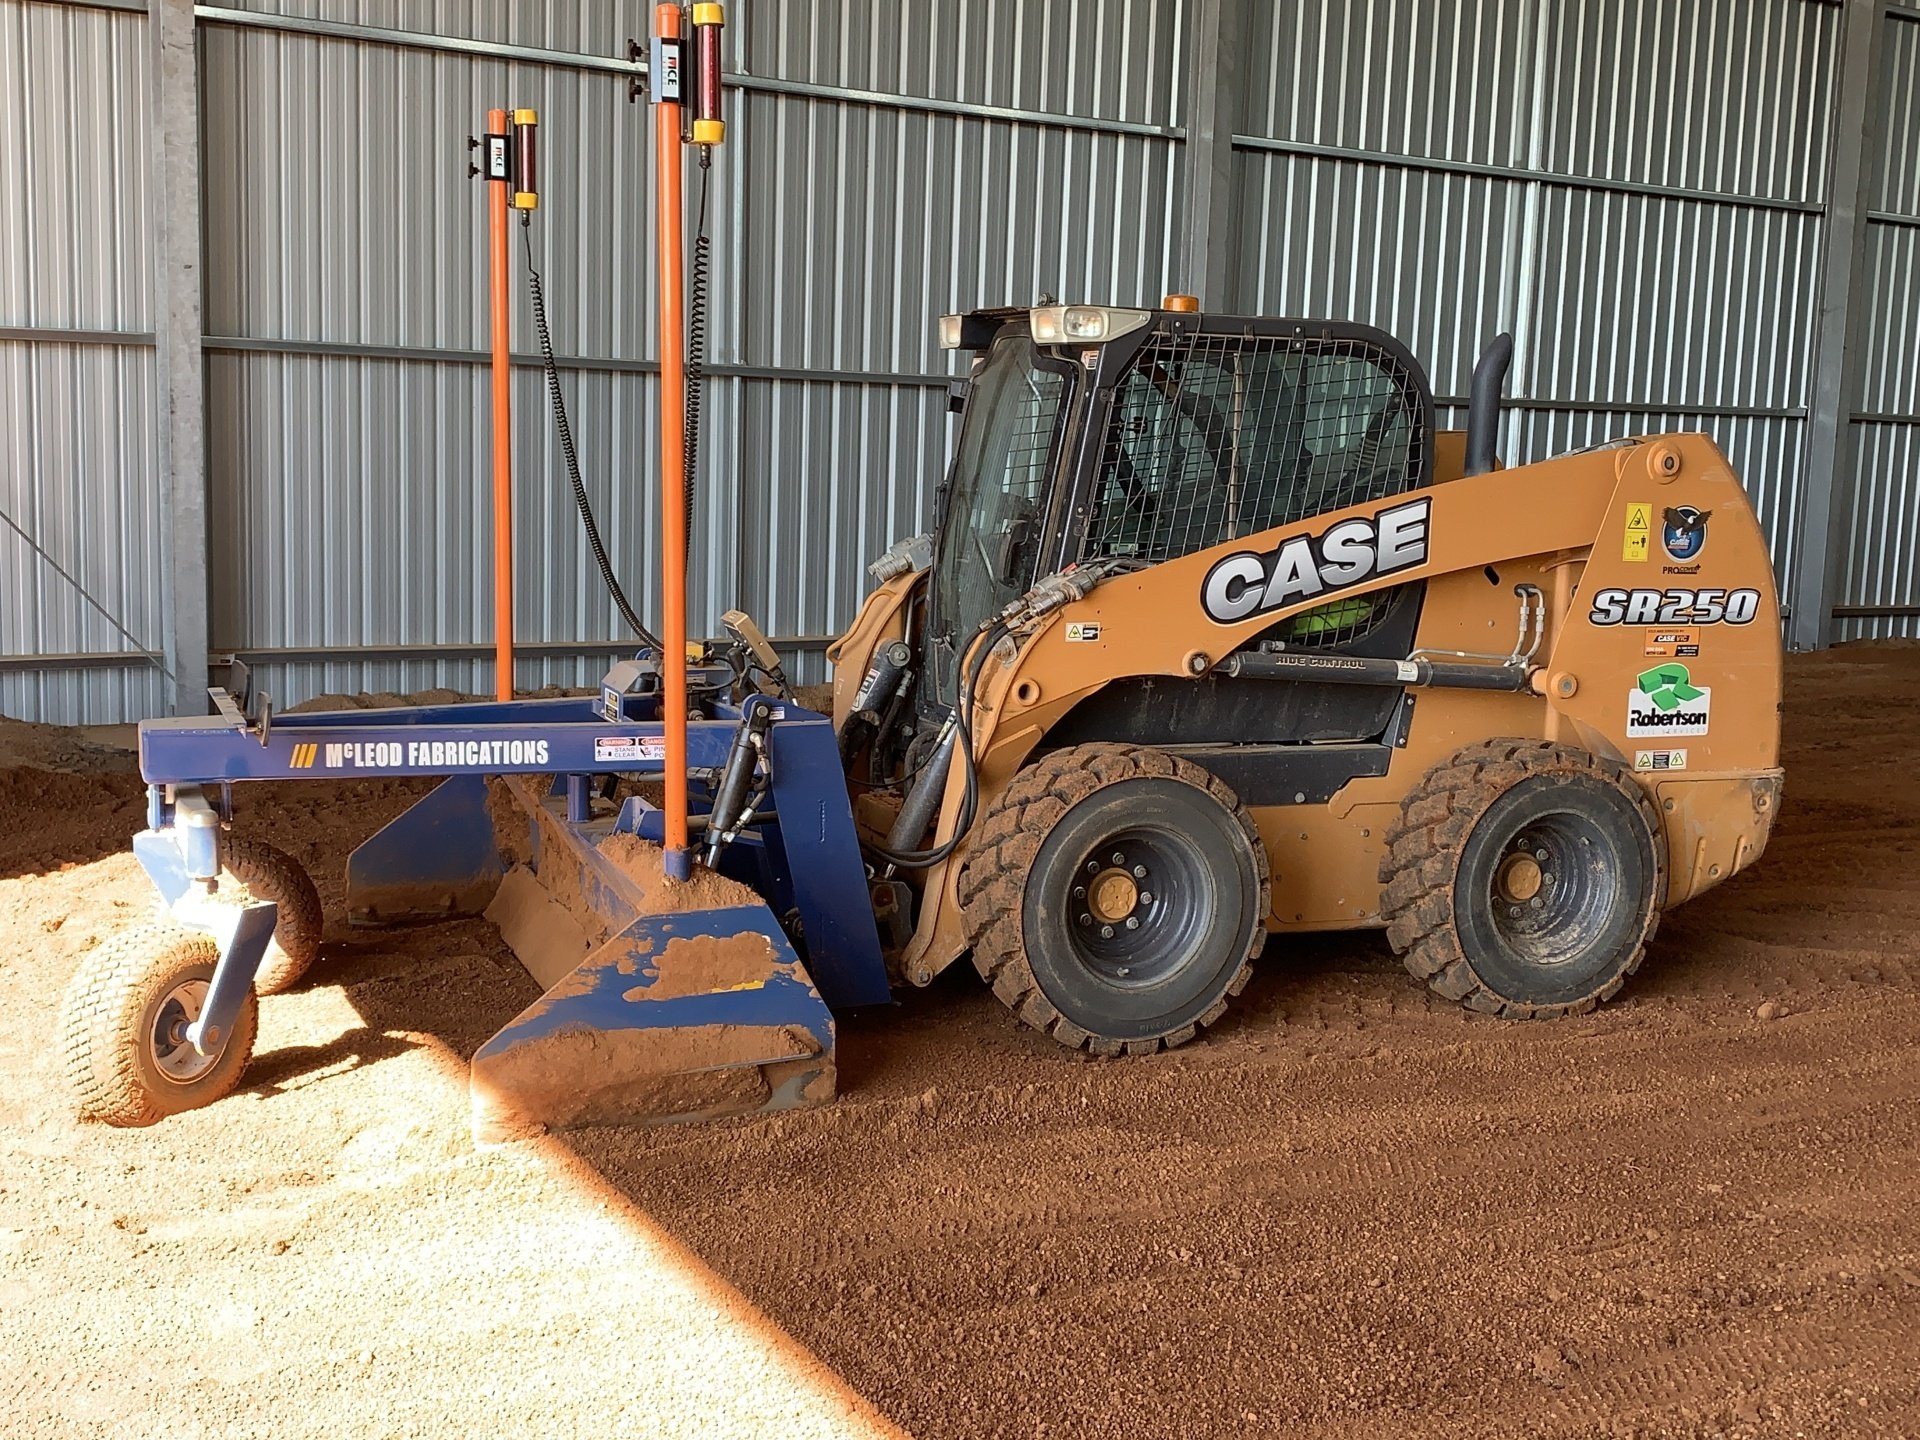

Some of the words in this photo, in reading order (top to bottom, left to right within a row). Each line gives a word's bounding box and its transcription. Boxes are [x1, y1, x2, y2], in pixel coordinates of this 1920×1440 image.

[1205, 500, 1428, 620] CASE
[1590, 588, 1761, 624] SR250
[1275, 655, 1307, 667] RIDE
[1308, 658, 1367, 670] CONTROL
[1630, 707, 1707, 727] Robertson
[408, 740, 549, 767] FABRICATIONS
